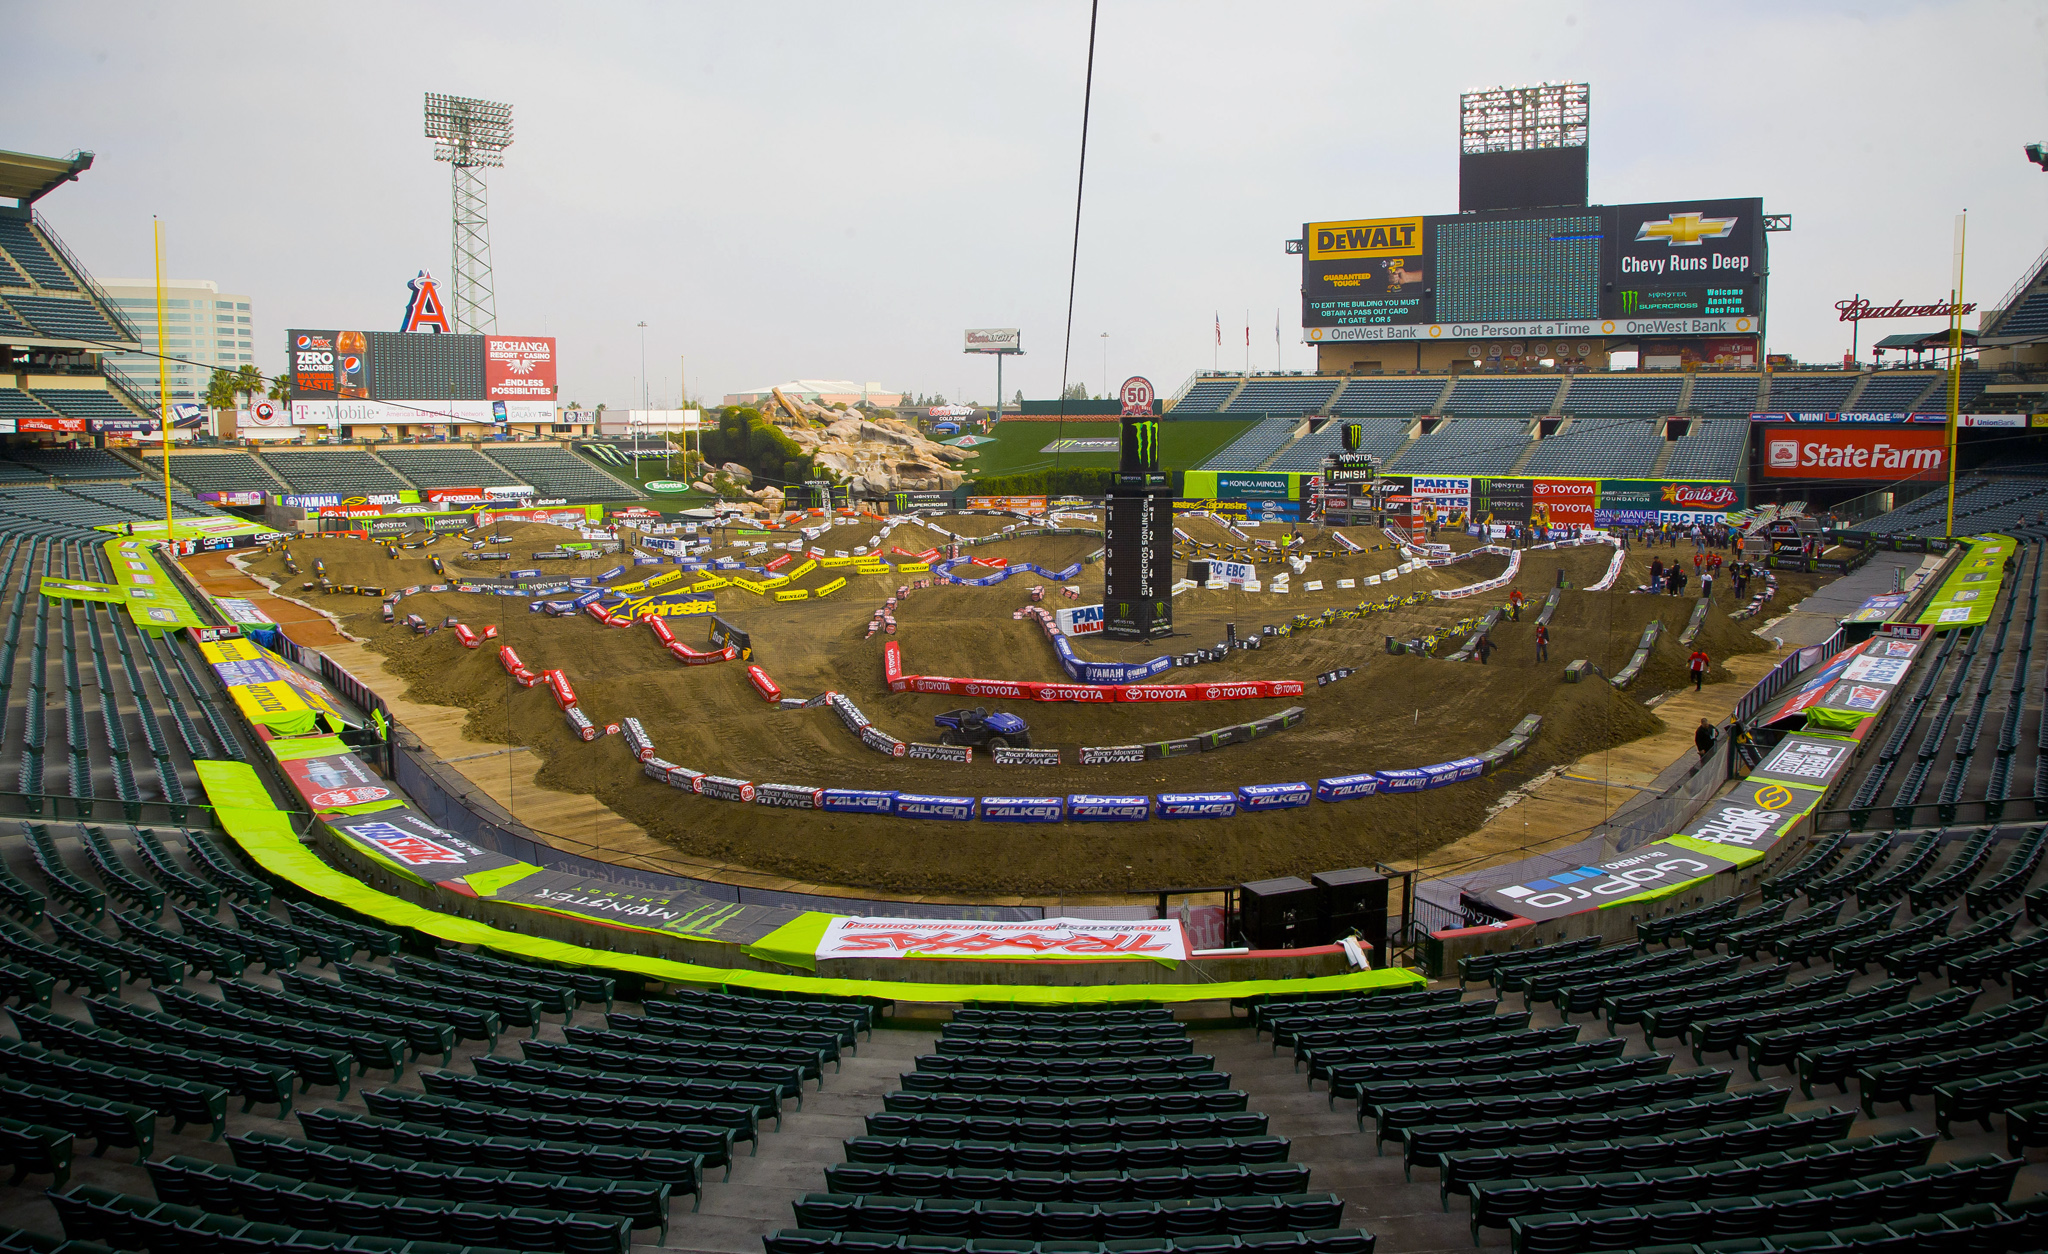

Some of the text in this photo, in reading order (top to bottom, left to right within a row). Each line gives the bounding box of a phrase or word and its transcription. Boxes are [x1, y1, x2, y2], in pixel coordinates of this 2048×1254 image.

[1317, 225, 1415, 250] DEWALT
[1622, 253, 1749, 275] Chevy Runs Deep
[1323, 273, 1371, 282] GUARANTEED
[1707, 288, 1743, 296] Welcome
[1352, 300, 1383, 308] BUILDING
[1639, 302, 1698, 310] SUPERCROSS
[1835, 298, 1977, 322] Budweiser
[1452, 323, 1590, 336] One Person at a Time
[1626, 319, 1726, 333] OneWest Bank
[968, 332, 1014, 343] Coors LIGHT
[1332, 327, 1416, 340] OneWest Bank
[490, 340, 550, 352] PECHANGA
[296, 352, 334, 364] ZERO
[298, 380, 334, 390] TASTE
[491, 387, 551, 395] POSSIBILITIES
[1128, 387, 1146, 402] 50
[416, 410, 446, 418] Largest
[929, 406, 951, 416] Coors
[1799, 413, 1824, 422] MINI
[1339, 453, 1372, 462] MONSTER
[1802, 443, 1942, 469] State Farm
[1334, 470, 1366, 479] FINISH
[1414, 479, 1468, 488] PARTS
[1551, 485, 1593, 494] TOYOTA
[1676, 486, 1736, 502] Carl's Jr.
[300, 496, 338, 507] YAMAHA
[1550, 504, 1592, 513] TOYOTA
[1621, 511, 1659, 520] MANUEL
[1660, 512, 1690, 524] EBC
[1695, 513, 1726, 524] EBC
[1108, 530, 1113, 539] 2
[204, 537, 234, 546] GoPro
[646, 540, 675, 549] PARTS
[1108, 549, 1113, 558] 3
[1780, 544, 1802, 553] thor
[793, 563, 815, 578] DUNLOP
[1108, 567, 1113, 576] 4
[1226, 564, 1245, 578] EBC
[652, 574, 679, 585] DUNLOP
[764, 579, 789, 588] DUNLOP
[697, 581, 726, 591] DUNLOP
[737, 580, 764, 593] DUNLOP
[821, 580, 845, 595] DUNLOP
[1108, 585, 1113, 595] 5
[637, 599, 717, 616] alpinestars
[656, 620, 672, 639] HONDA
[1893, 628, 1920, 636] MLB
[1156, 660, 1169, 669] YAMAHA
[1131, 667, 1148, 676] YAMAHA
[555, 670, 570, 693] HONDA
[925, 682, 951, 691] TOYOTA
[979, 685, 1020, 696] TOYOTA
[1058, 689, 1103, 699] TOYOTA
[1144, 689, 1186, 699] TOYOTA
[1223, 686, 1257, 696] TOYOTA
[1283, 685, 1301, 693] TOYOTA
[247, 685, 287, 712] DUNLOP
[1459, 764, 1483, 776] FALKEN
[1431, 770, 1458, 783] FALKEN
[1389, 777, 1427, 788] FALKEN
[763, 789, 812, 800] ROCKY MOUNTAIN
[1332, 782, 1377, 796] FALKEN
[826, 795, 891, 808] FALKEN
[1250, 793, 1309, 805] FALKEN
[898, 804, 967, 817] FALKEN
[986, 807, 1059, 817] FALKEN
[1074, 807, 1147, 816] FALKEN
[1165, 804, 1235, 815] FALKEN
[1691, 808, 1746, 843] OPTICS
[1718, 809, 1781, 845] SMITH
[1525, 858, 1709, 908] GoPro
[571, 887, 670, 905] ENERGY
[535, 888, 679, 920] MONSTER
